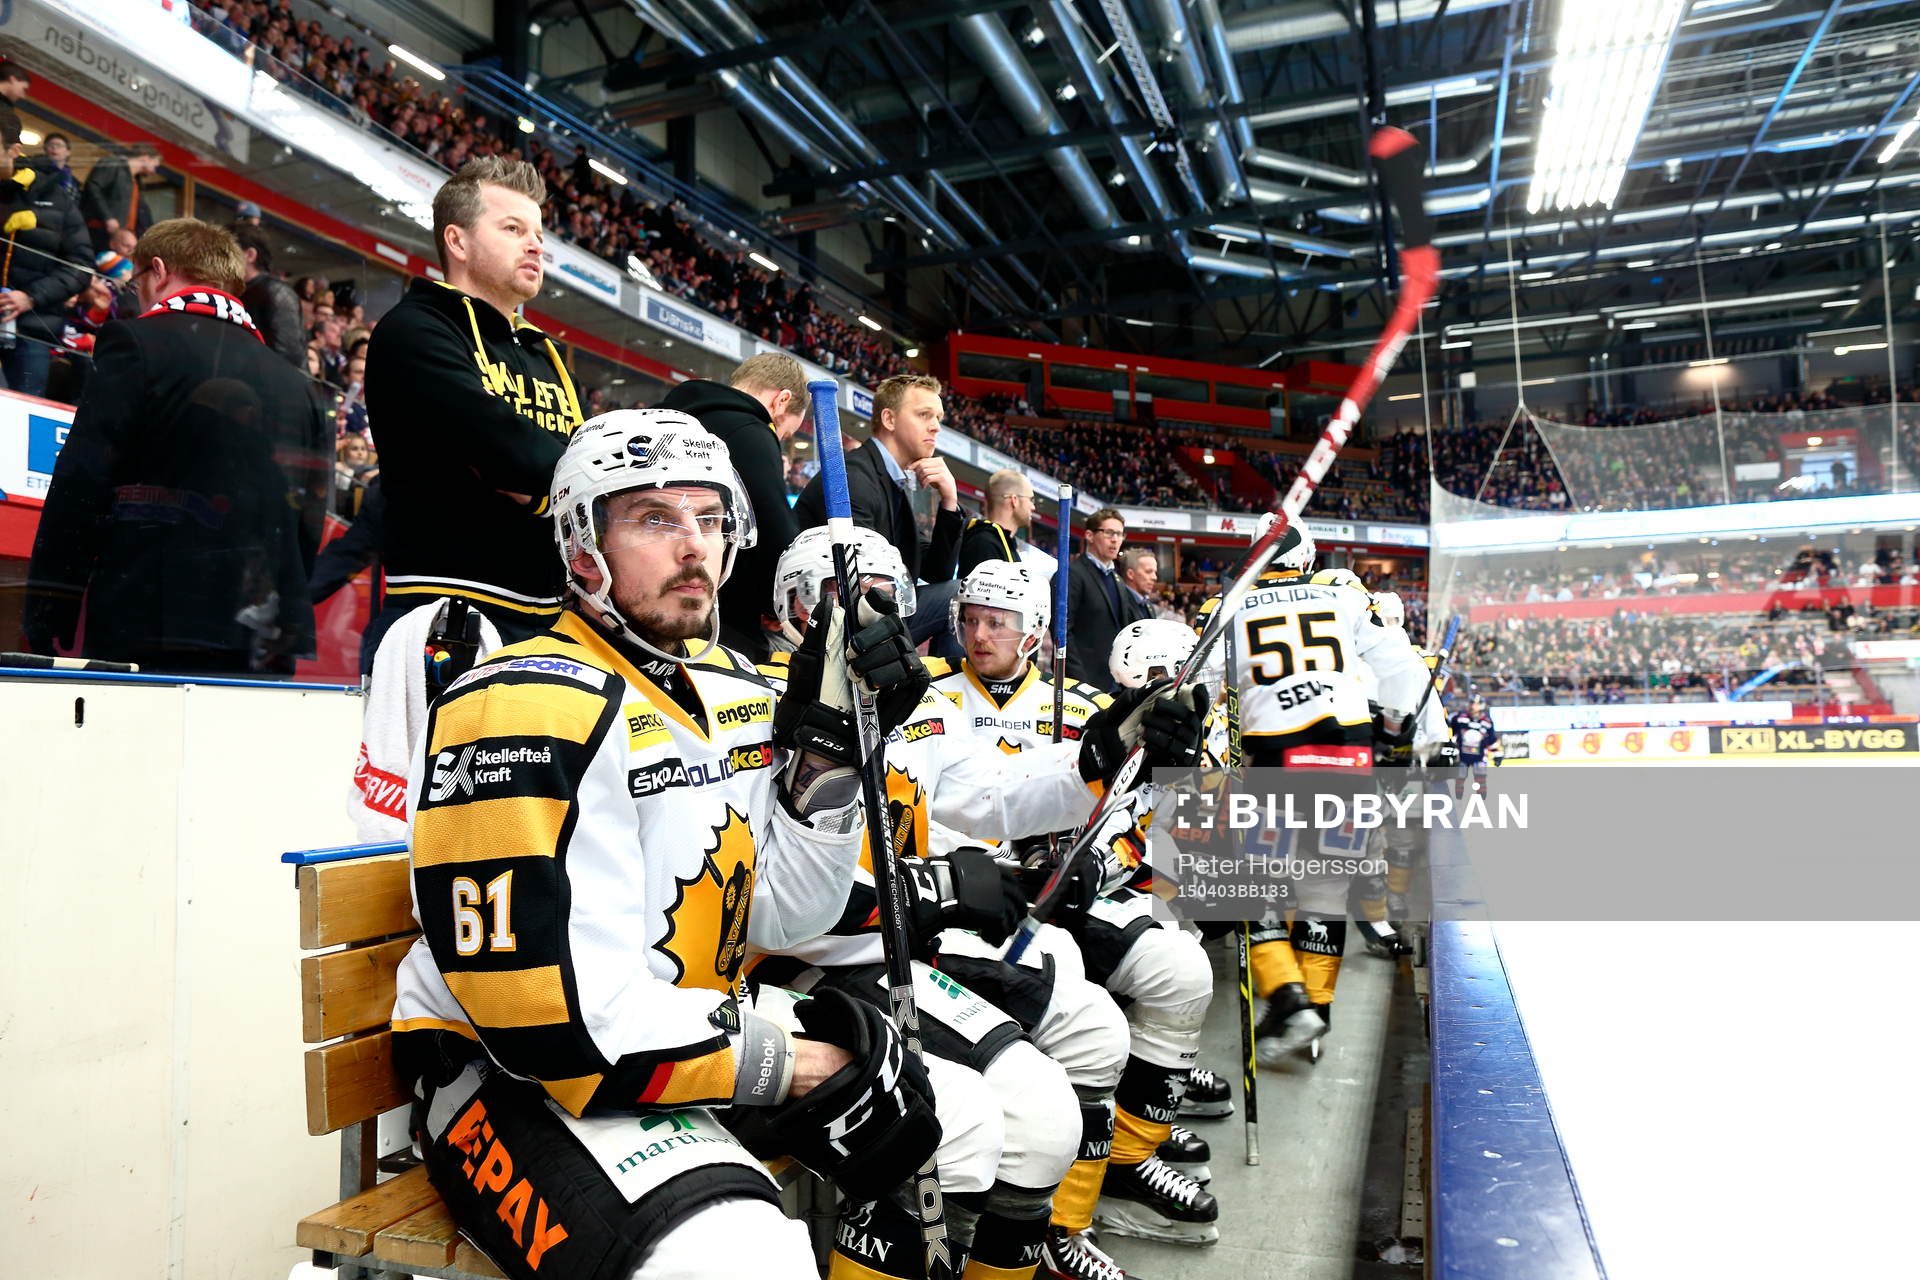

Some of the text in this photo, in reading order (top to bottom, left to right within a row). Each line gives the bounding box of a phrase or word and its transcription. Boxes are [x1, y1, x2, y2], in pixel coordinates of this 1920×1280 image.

[1246, 611, 1344, 686] 55
[989, 684, 1015, 695] SHL
[717, 701, 768, 724] engcon
[975, 716, 1031, 730] BOLIDEN
[904, 719, 944, 743] skebo
[1037, 723, 1079, 740] skbo
[1778, 729, 1906, 750] XL-BYGG
[475, 746, 551, 766] Skellefteå
[474, 767, 512, 785] Kraft
[1113, 760, 1137, 796] CCM
[451, 870, 517, 957] 61
[752, 1037, 776, 1096] Reebok
